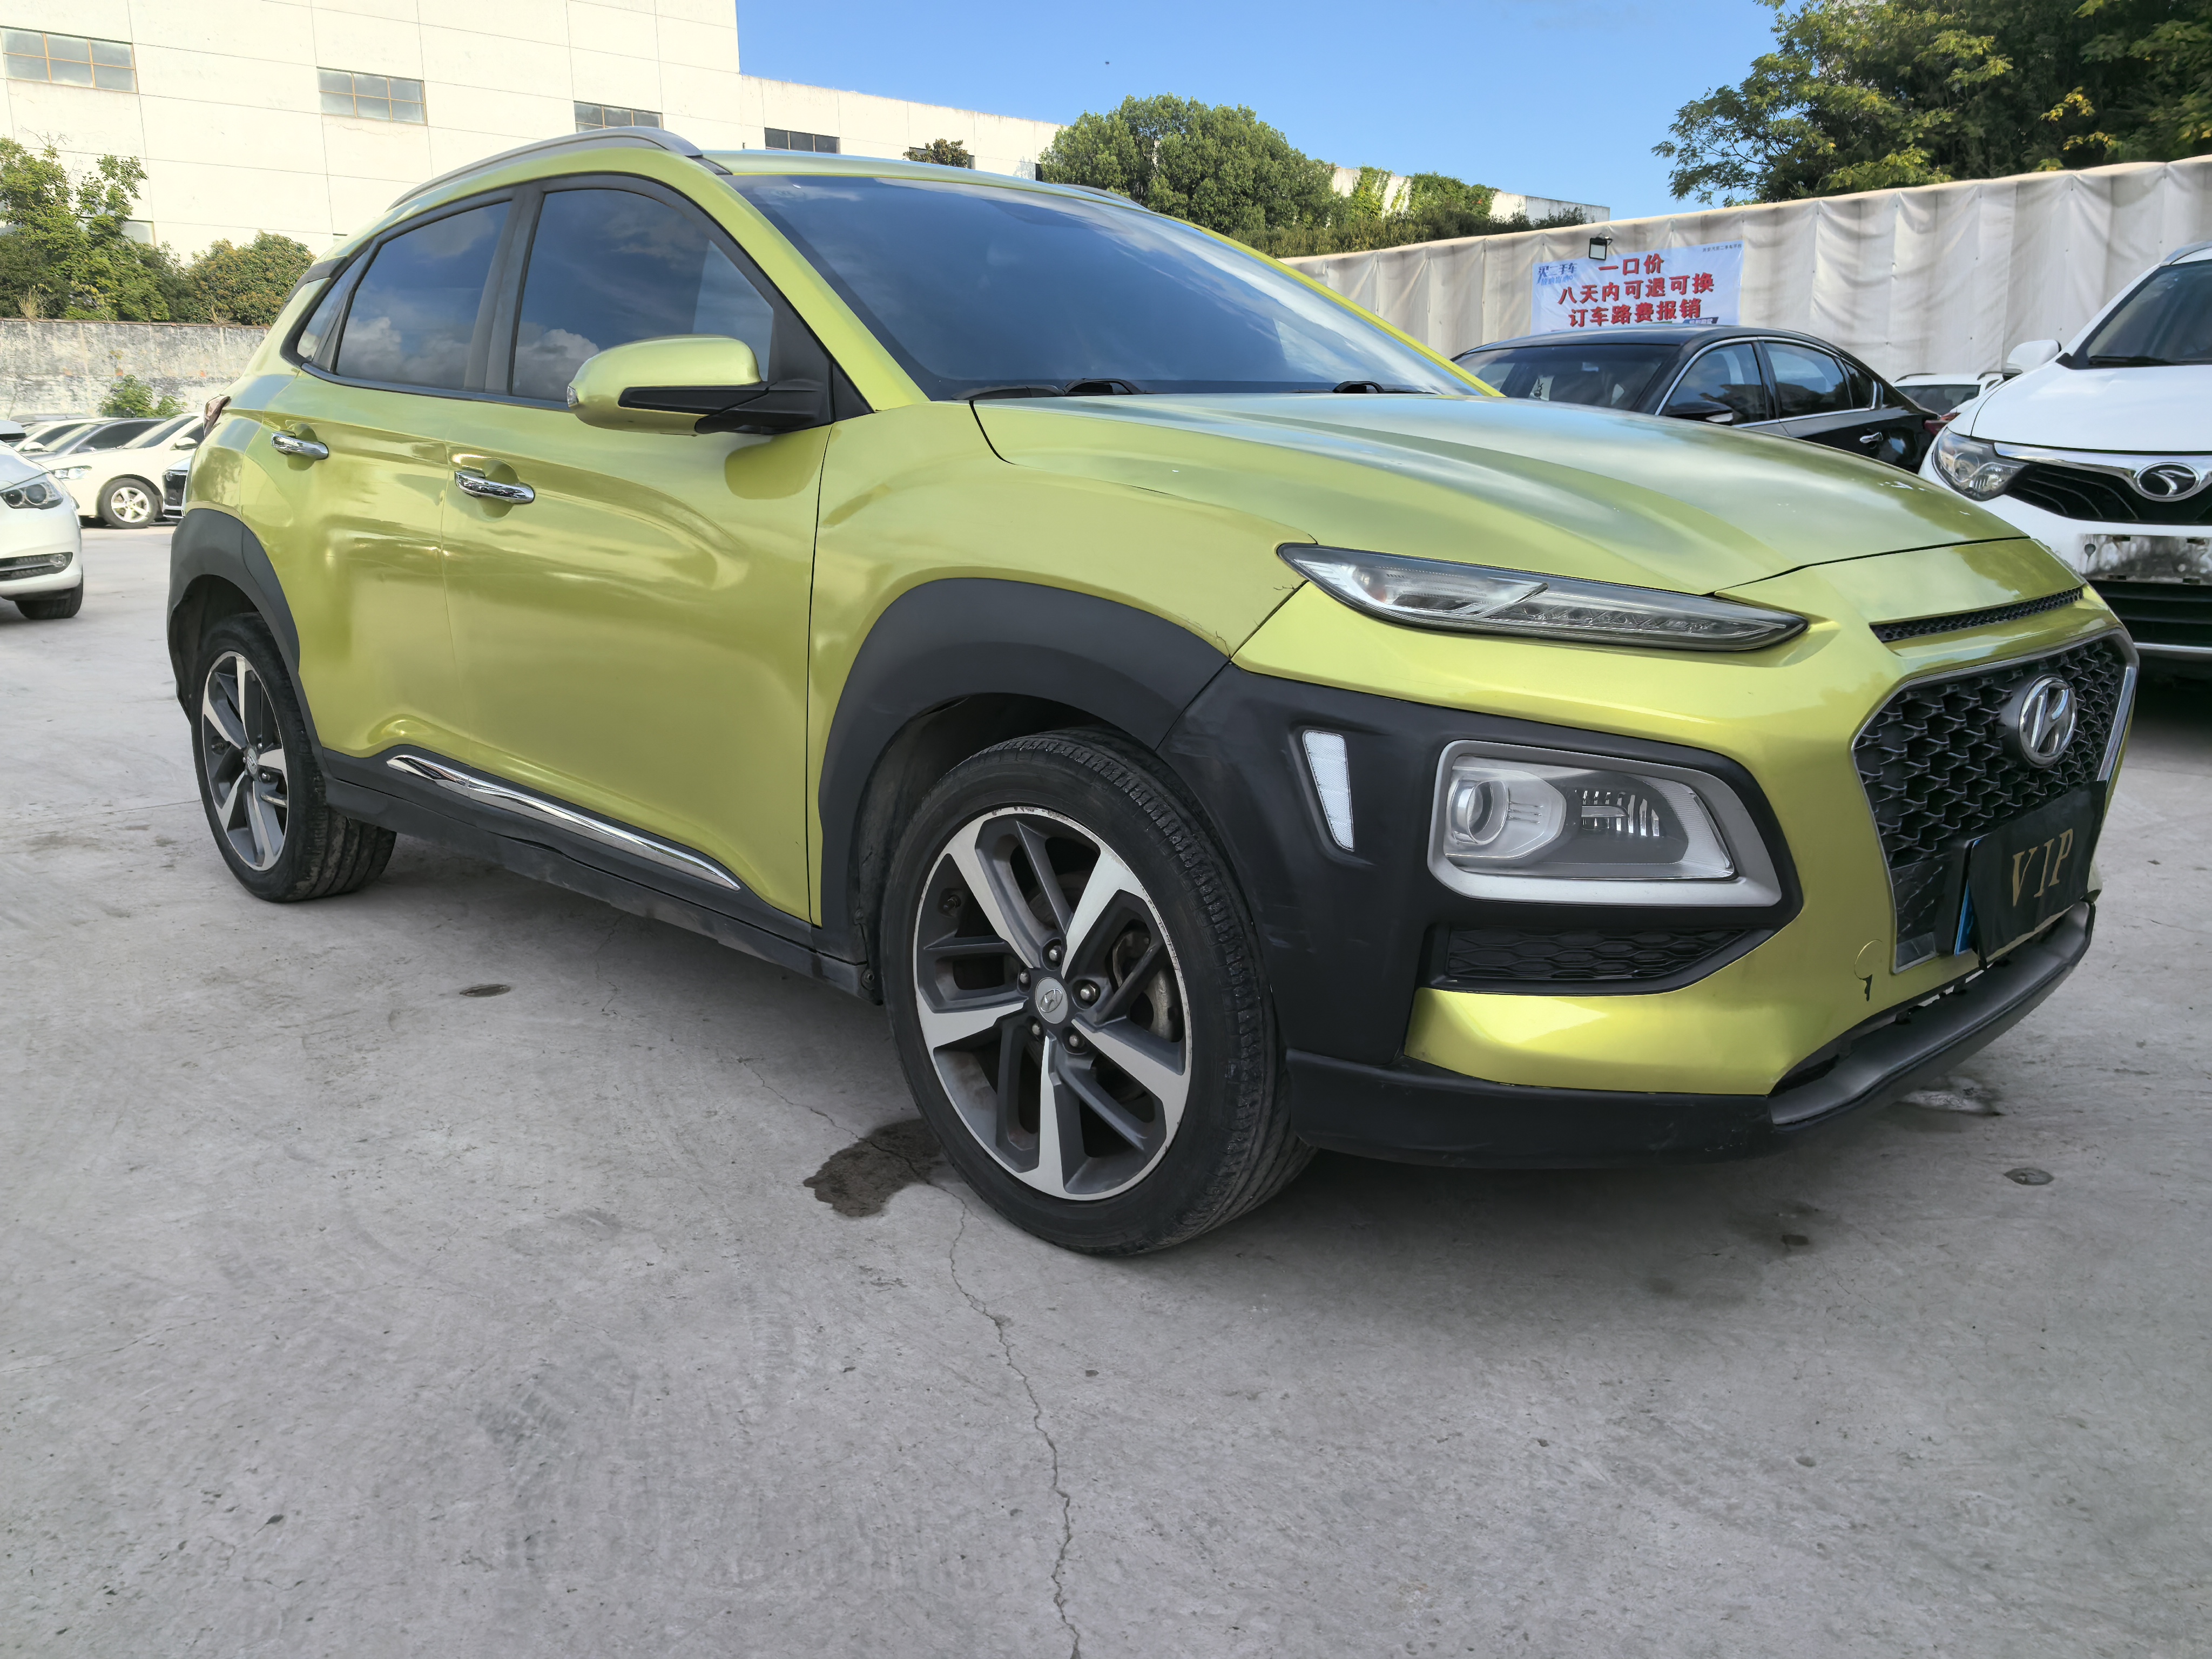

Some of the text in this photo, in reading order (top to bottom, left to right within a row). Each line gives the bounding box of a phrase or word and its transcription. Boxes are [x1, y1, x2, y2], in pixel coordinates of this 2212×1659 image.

[1599, 253, 1664, 275] 一口价
[1557, 272, 1714, 305] 八天内可退可换
[1568, 298, 1702, 327] 订车路费报销
[2012, 828, 2074, 907] VIP
